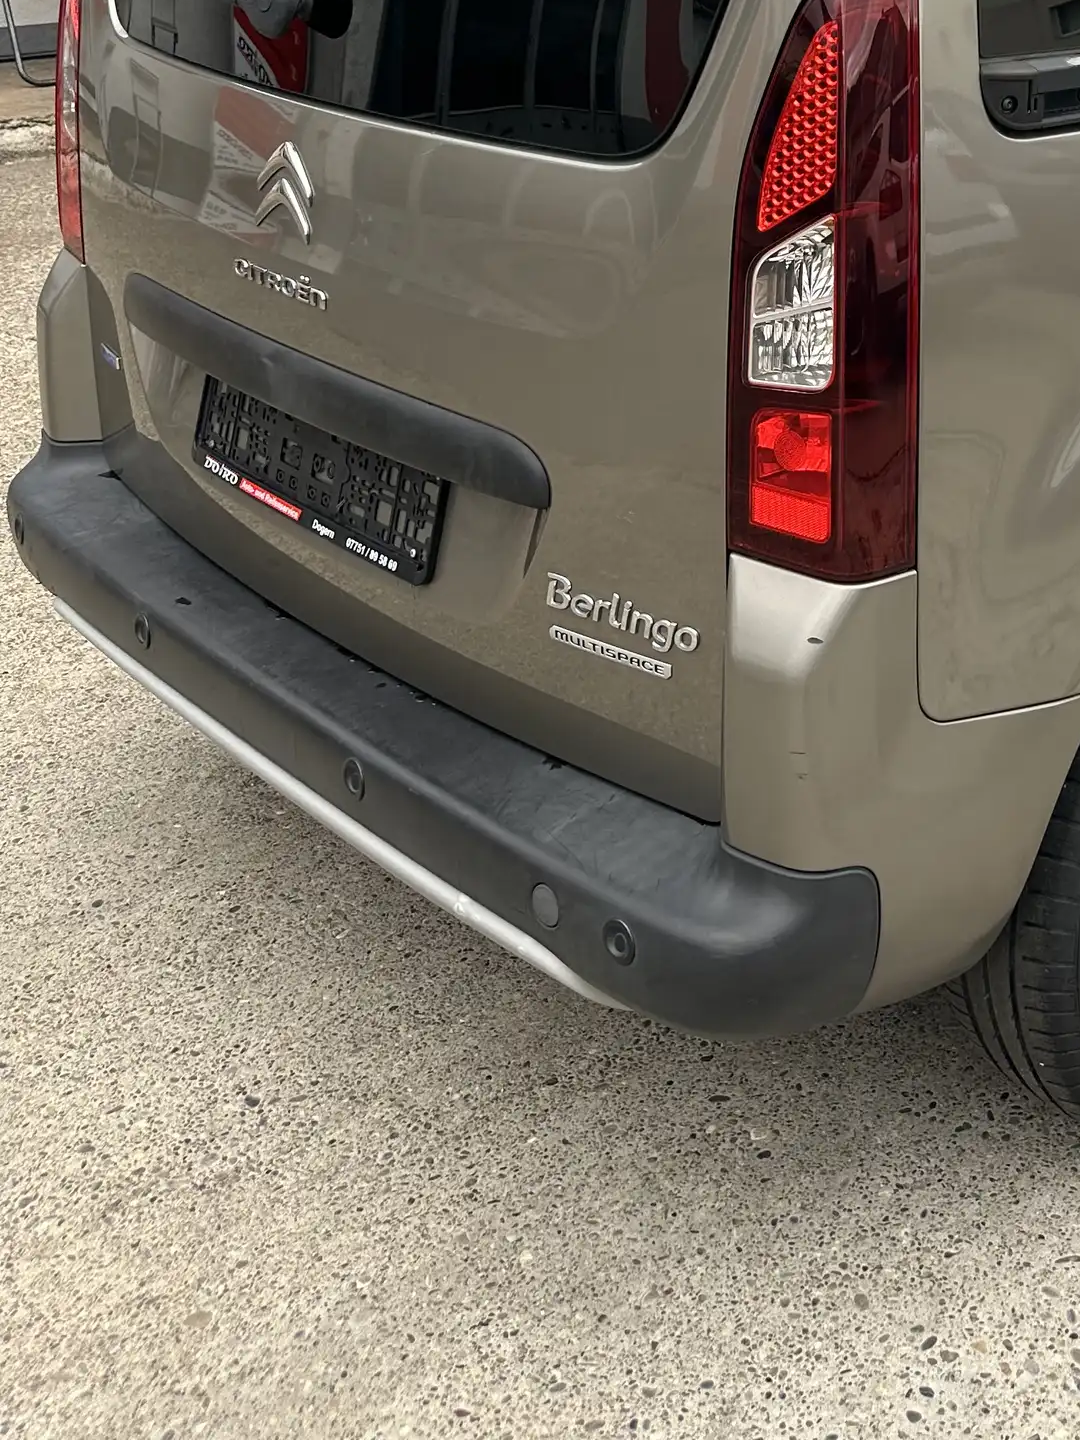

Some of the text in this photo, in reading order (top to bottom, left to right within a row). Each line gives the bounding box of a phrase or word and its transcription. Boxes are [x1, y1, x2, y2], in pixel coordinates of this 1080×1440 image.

[233, 257, 328, 310] CITROËN
[345, 537, 366, 555] 07751
[546, 572, 700, 653] Berlingo
[555, 630, 665, 675] MULTISPACE
